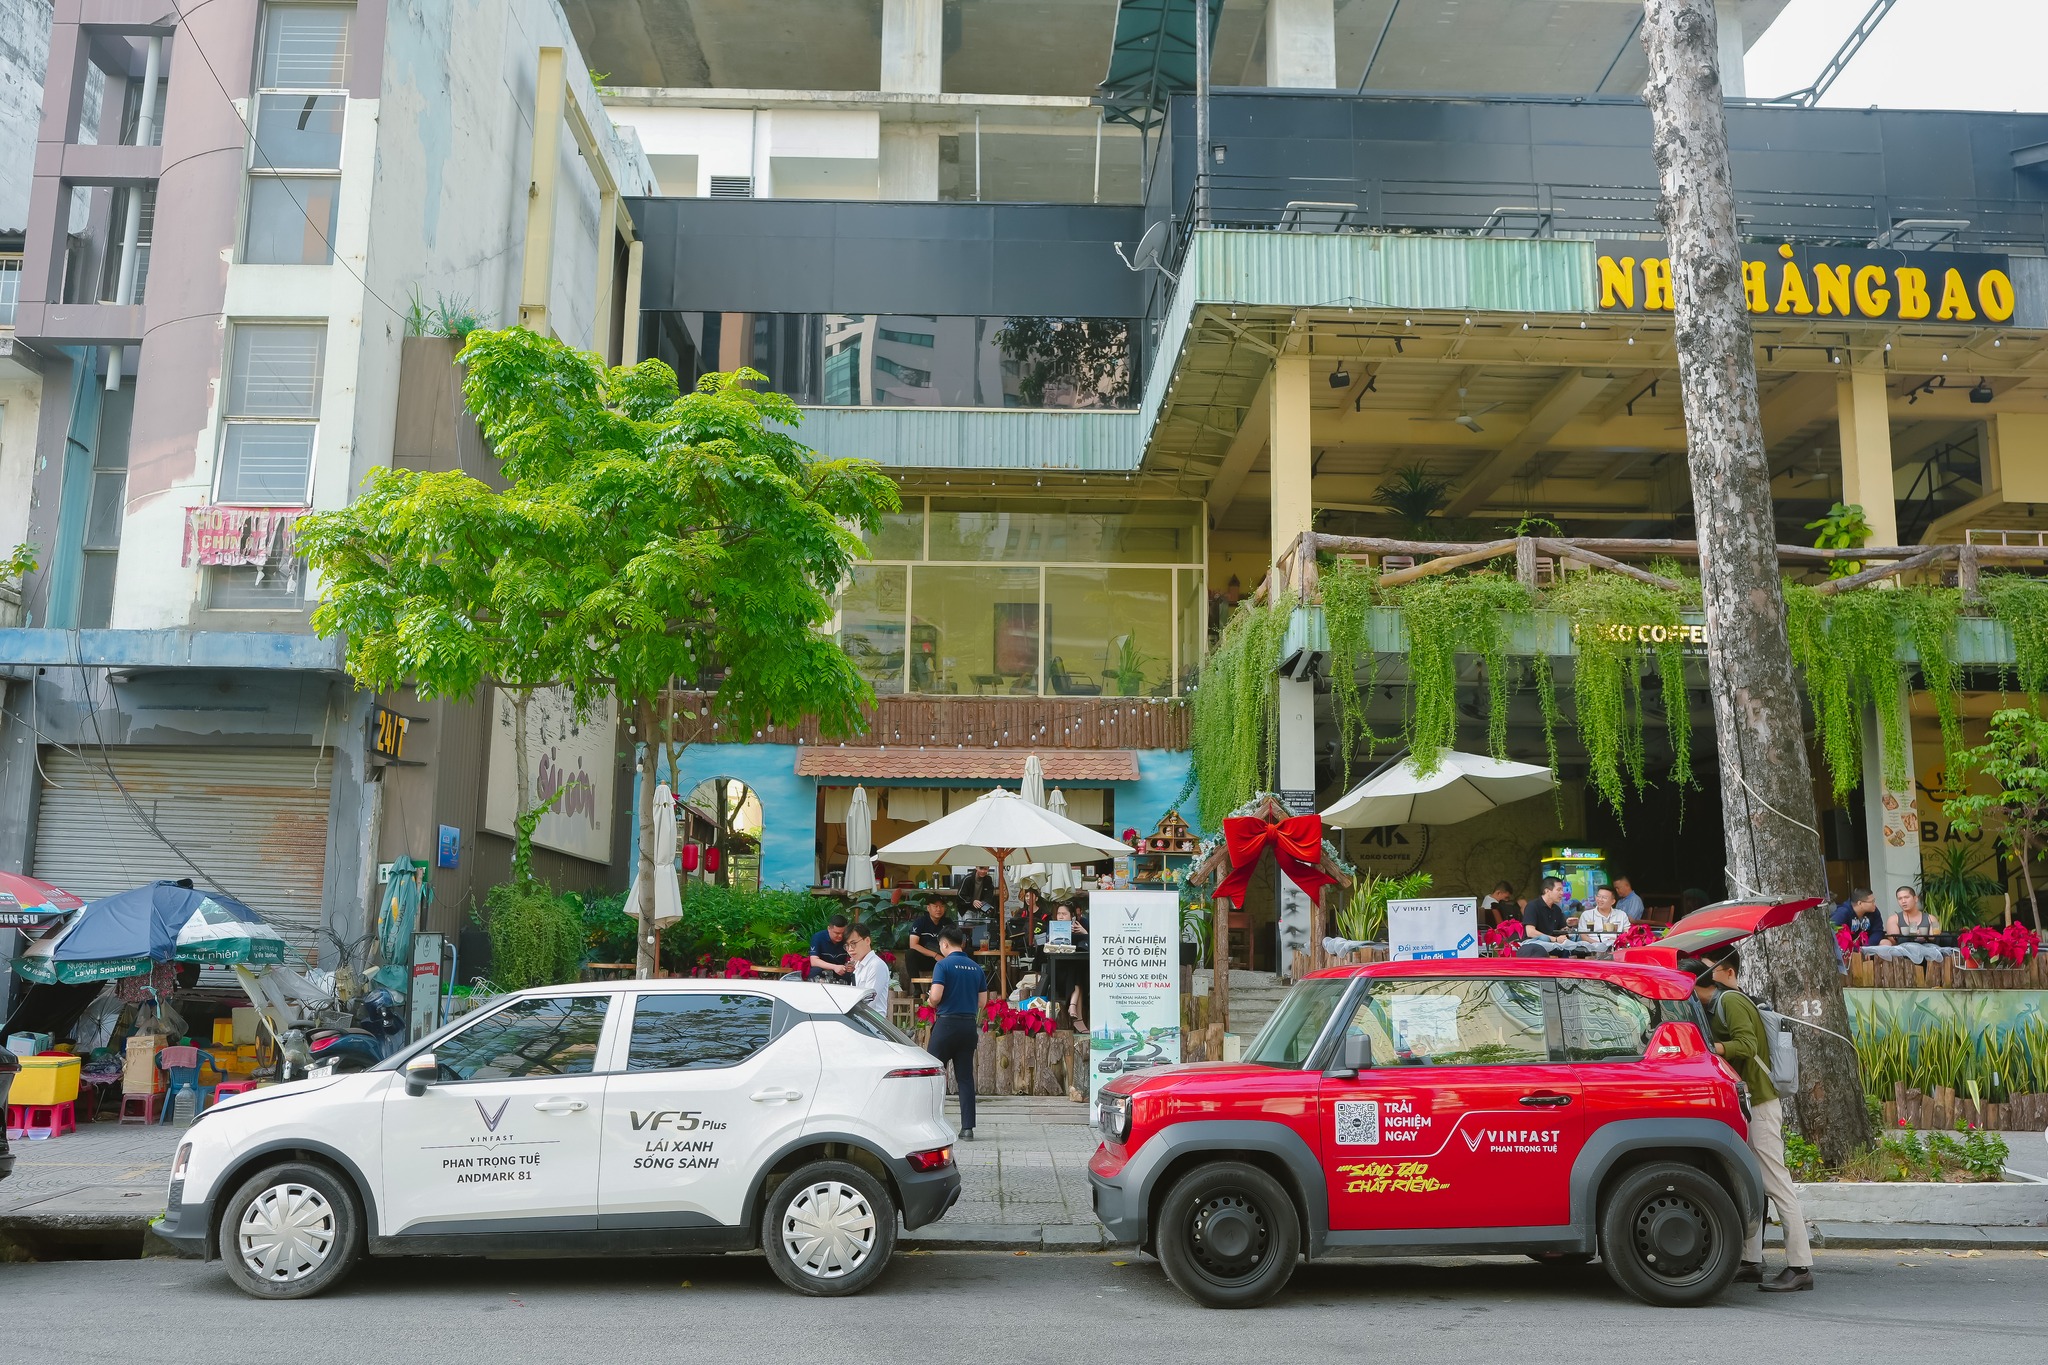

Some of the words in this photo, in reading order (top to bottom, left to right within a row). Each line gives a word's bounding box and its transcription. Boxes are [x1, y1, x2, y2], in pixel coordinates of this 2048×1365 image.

[377, 710, 405, 757] 24/7
[1103, 934, 1125, 944] TRẢI
[1128, 935, 1166, 946] NGHIỆM
[1117, 946, 1124, 955] Ô
[1128, 946, 1140, 955] TÔ
[1144, 946, 1167, 957] ĐIỆN
[100, 964, 136, 974] Sparkling
[1103, 958, 1138, 966] THÔNG
[1137, 981, 1152, 989] VIỆT
[1801, 1000, 1822, 1016] 13
[1384, 1099, 1412, 1113] TRẢI
[630, 1111, 702, 1130] VF5
[702, 1120, 727, 1130] Plus
[1384, 1114, 1432, 1129] NGHIỆM
[1385, 1131, 1418, 1141] NGAY
[1487, 1130, 1560, 1142] VINFAST
[645, 1138, 669, 1152] LÁI
[671, 1141, 714, 1152] XANH
[1514, 1146, 1540, 1154] TRỌNG
[1543, 1144, 1558, 1154] TUỆ
[443, 1159, 473, 1168] PHAN
[477, 1156, 516, 1168] TRỌNG
[519, 1152, 540, 1166] TUỆ
[633, 1154, 674, 1168] SỐNG
[678, 1155, 719, 1168] SÀNH
[1349, 1162, 1394, 1176] SÁNG
[1396, 1162, 1428, 1177] TẠO
[457, 1172, 514, 1183] ANDMARK
[518, 1171, 532, 1180] 81
[1348, 1176, 1392, 1193] CHẤT
[1390, 1176, 1440, 1192] RIÊNG
